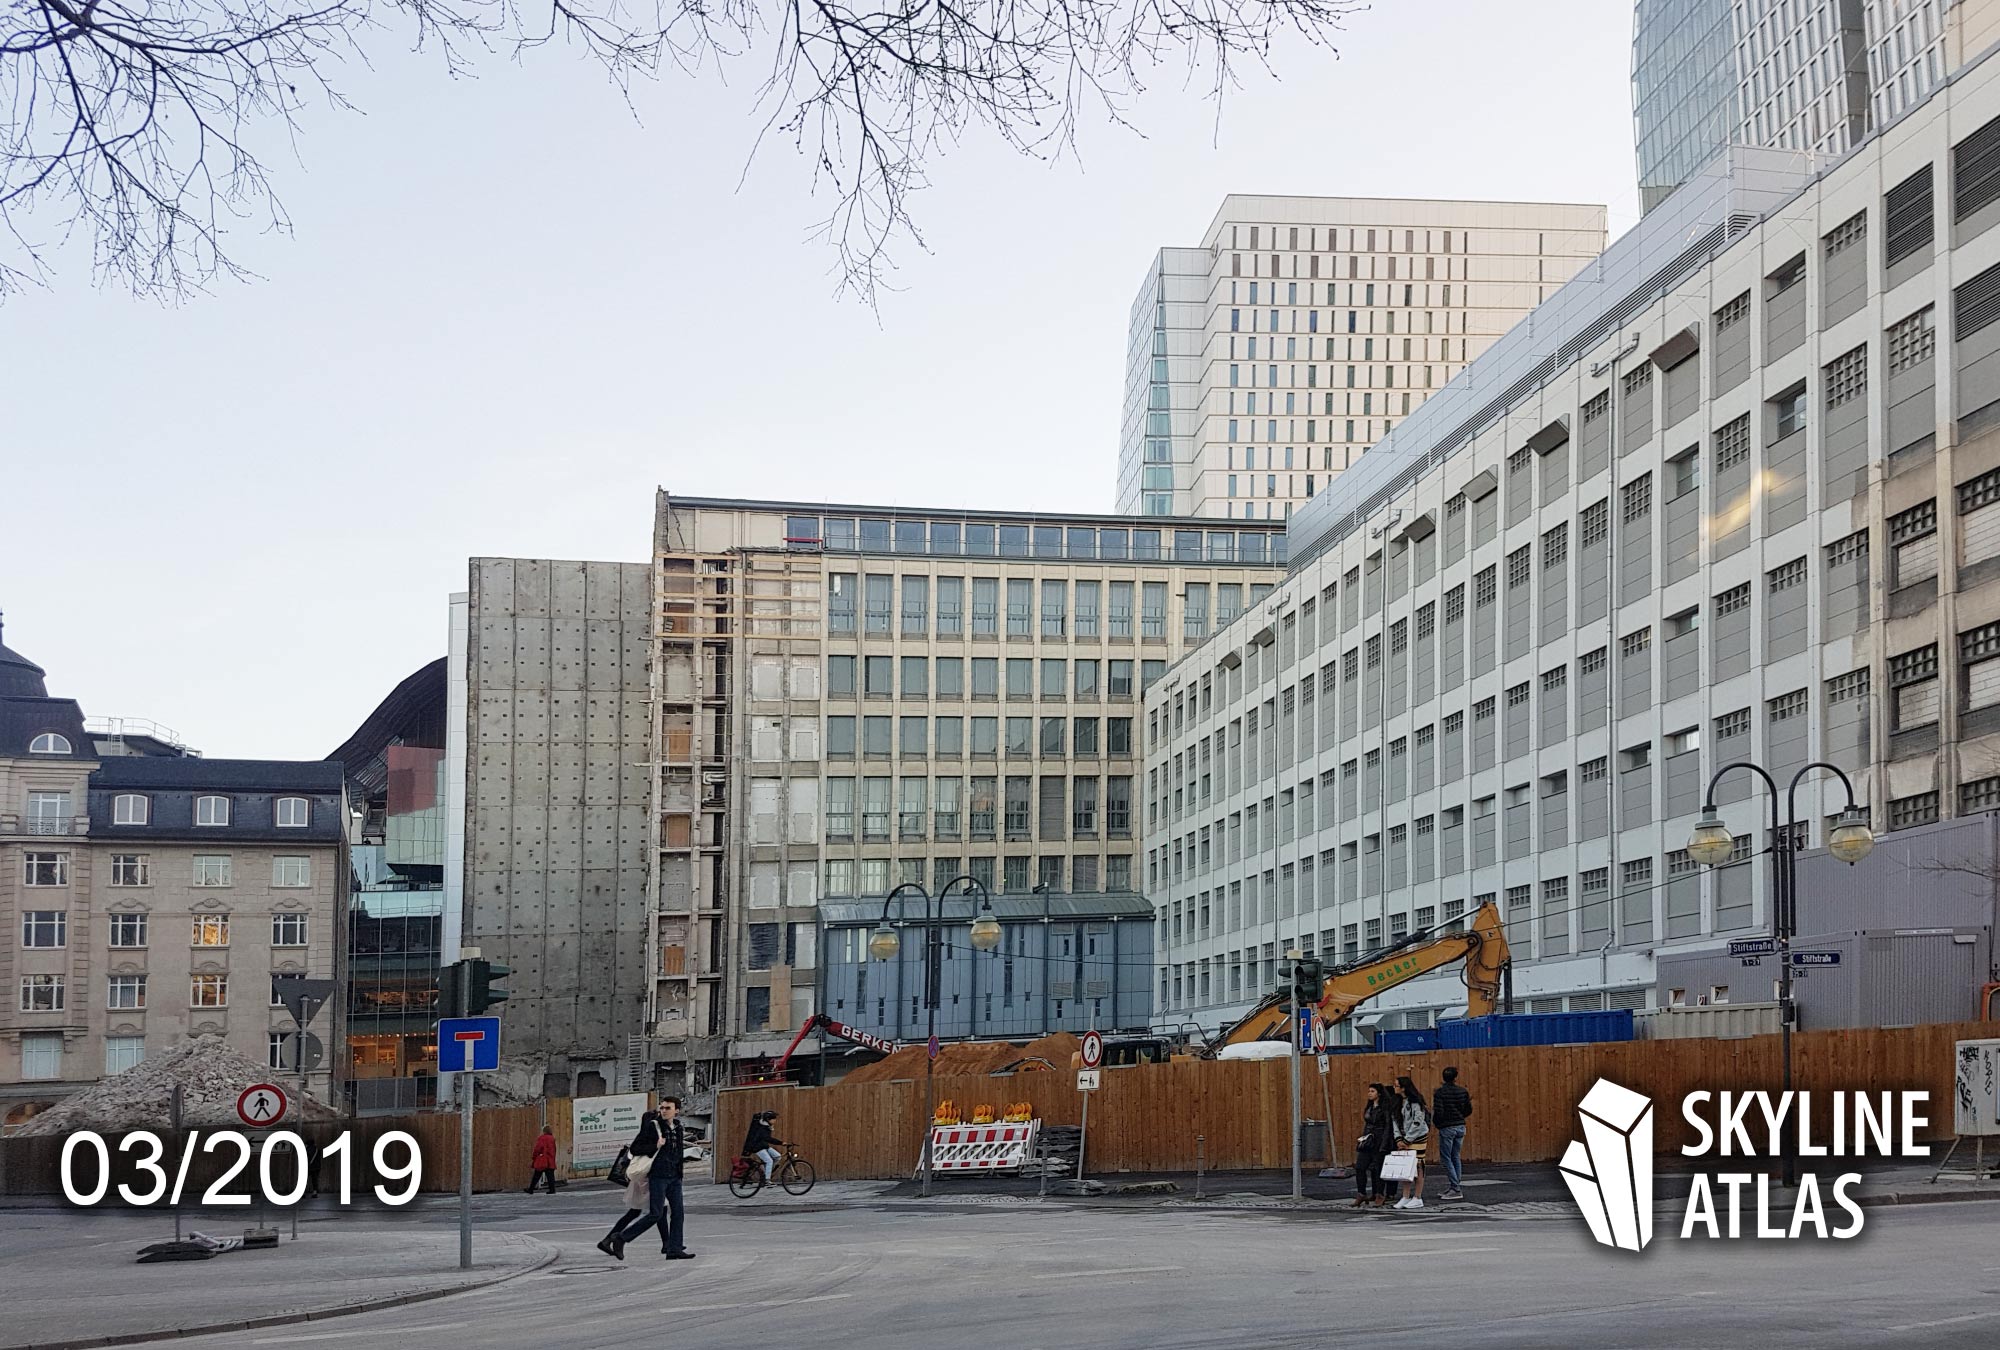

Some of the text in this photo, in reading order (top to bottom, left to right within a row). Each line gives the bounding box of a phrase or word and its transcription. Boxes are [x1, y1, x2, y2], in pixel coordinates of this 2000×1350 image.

[1733, 942, 1771, 952] Stiftstraße
[1802, 954, 1832, 963] Stiftstraße
[1367, 957, 1417, 985] Becker
